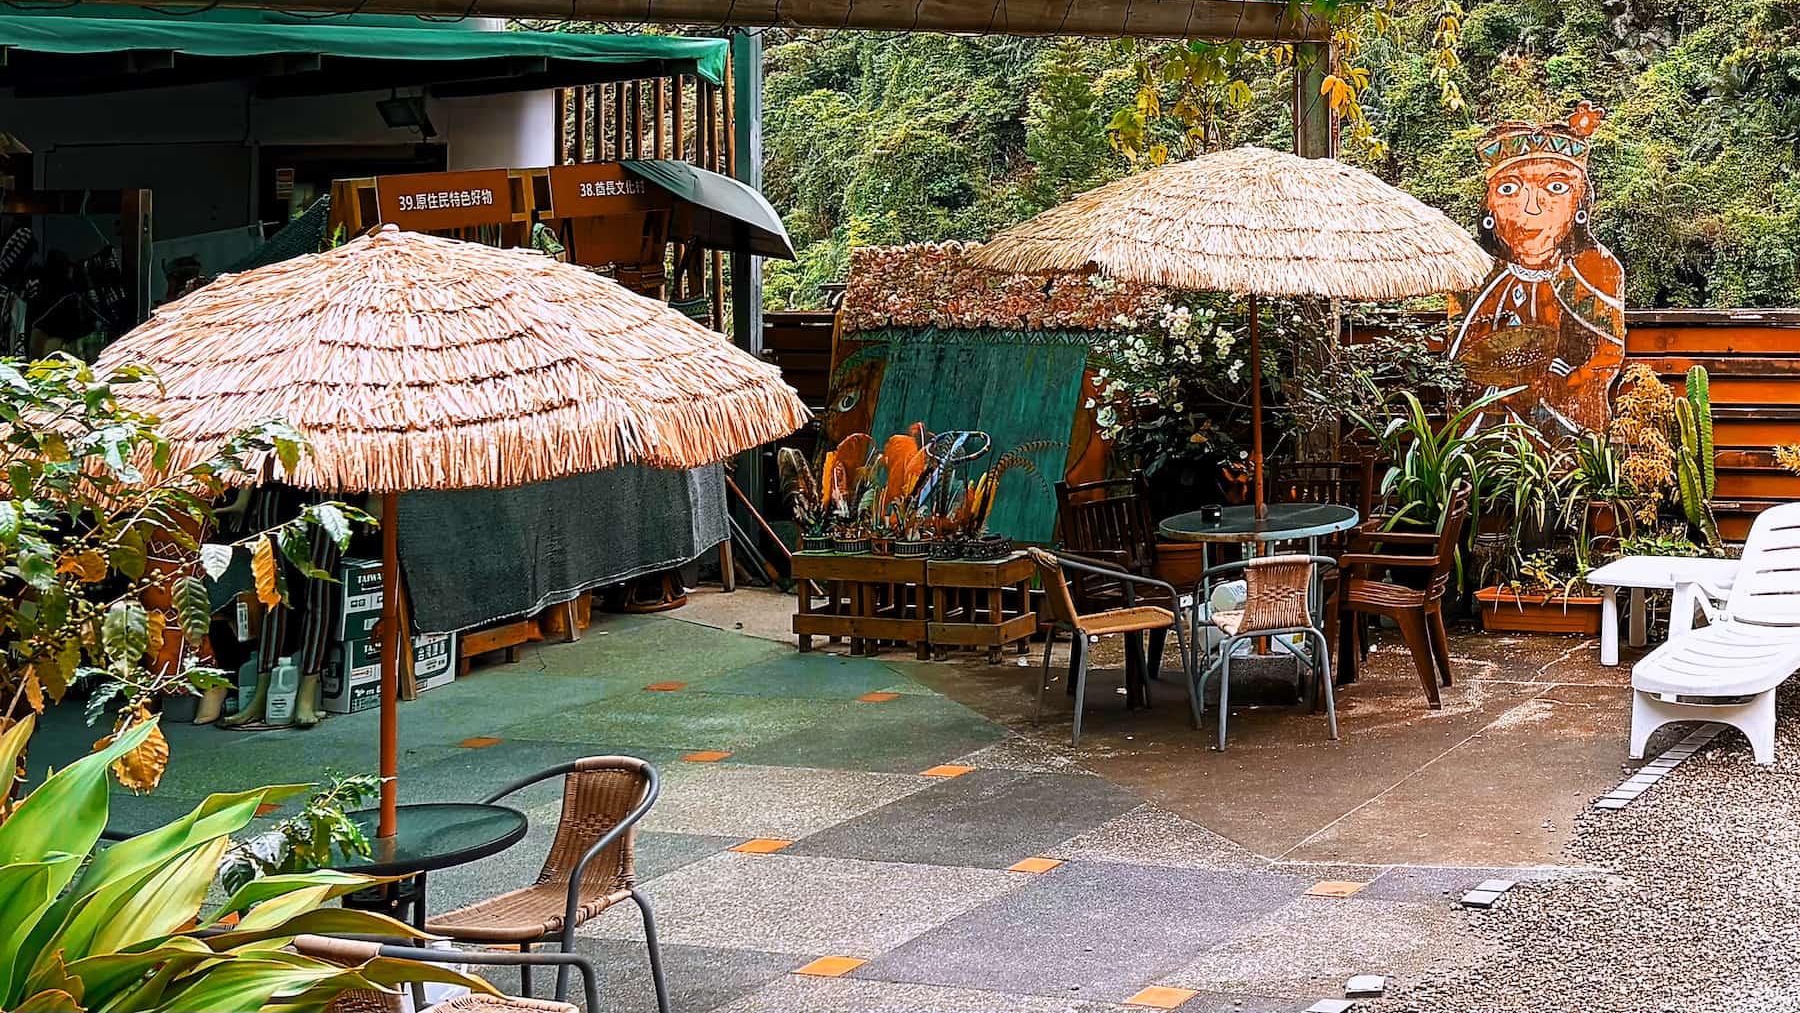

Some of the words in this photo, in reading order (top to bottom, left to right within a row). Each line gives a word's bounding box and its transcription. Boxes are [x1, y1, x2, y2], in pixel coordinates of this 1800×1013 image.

[580, 180, 645, 197] 38.酋長文化村
[399, 189, 493, 211] 39.原住民特色好物
[357, 572, 384, 584] TAIWA
